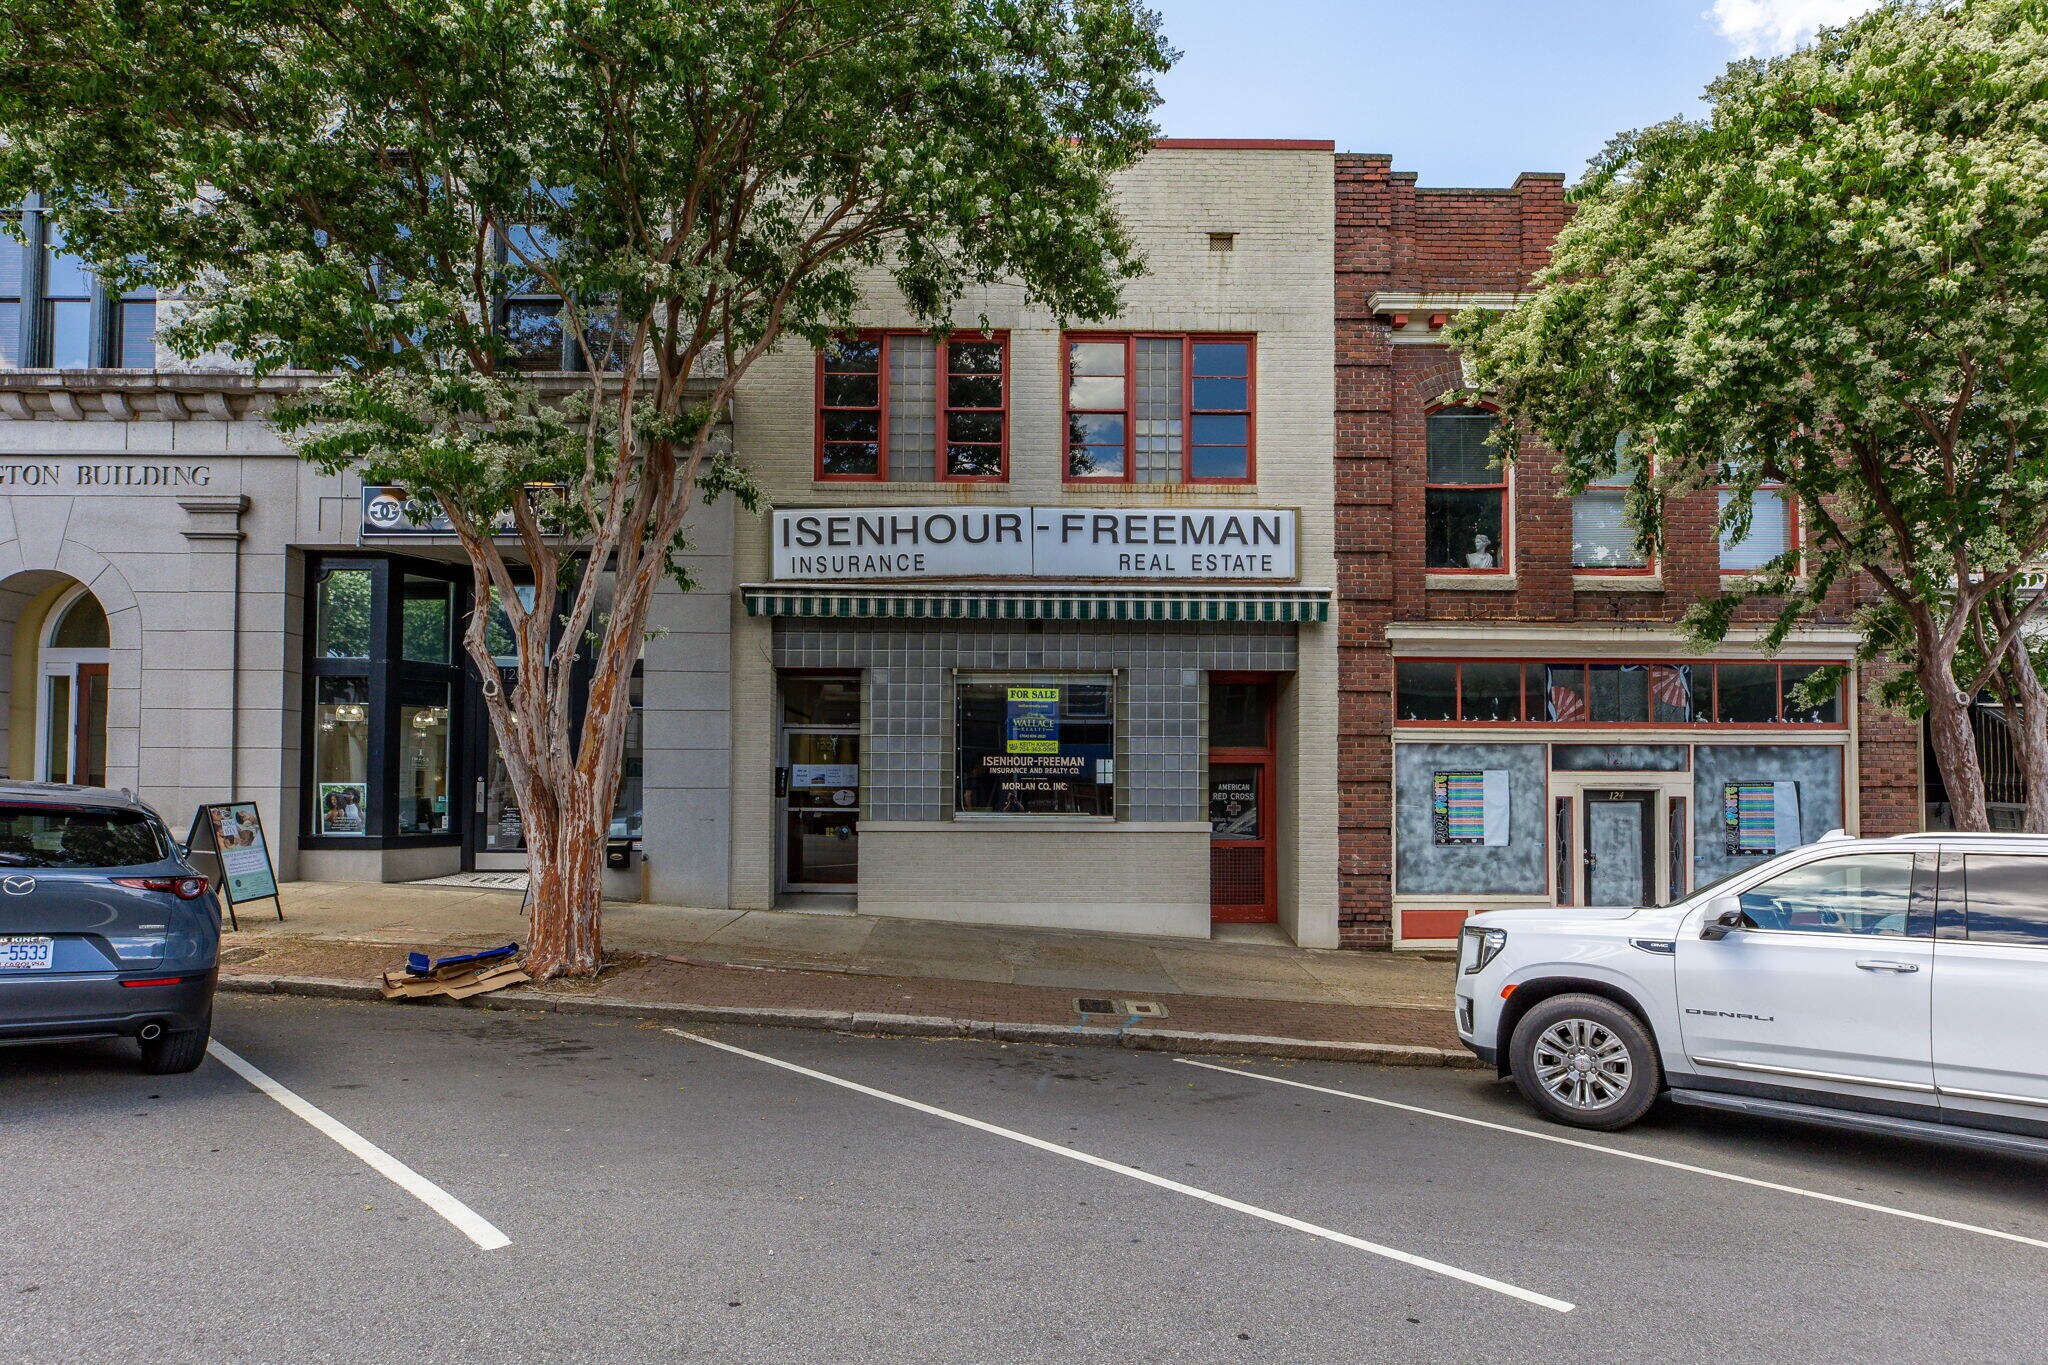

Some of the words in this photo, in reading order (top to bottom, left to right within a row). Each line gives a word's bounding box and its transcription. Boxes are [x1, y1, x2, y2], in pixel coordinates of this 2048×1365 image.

[76, 465, 211, 486] BUILDING
[783, 513, 1023, 547] ISENHOUR
[1061, 514, 1281, 545] FREEMAN
[791, 553, 926, 574] INSURANCE
[1119, 553, 1176, 571] REAL
[1191, 554, 1273, 572] ESTATE
[1010, 690, 1029, 699] FOR
[1031, 690, 1057, 699] SALE
[1013, 719, 1055, 728] WALLACE
[983, 756, 1085, 767] ISENHOUR-FREEMAN
[990, 767, 1027, 775] INSURANCE
[1002, 782, 1036, 791] MORLAN
[1038, 783, 1052, 791] CO.
[1609, 792, 1625, 800] 124
[1685, 1008, 1774, 1022] DENALI
